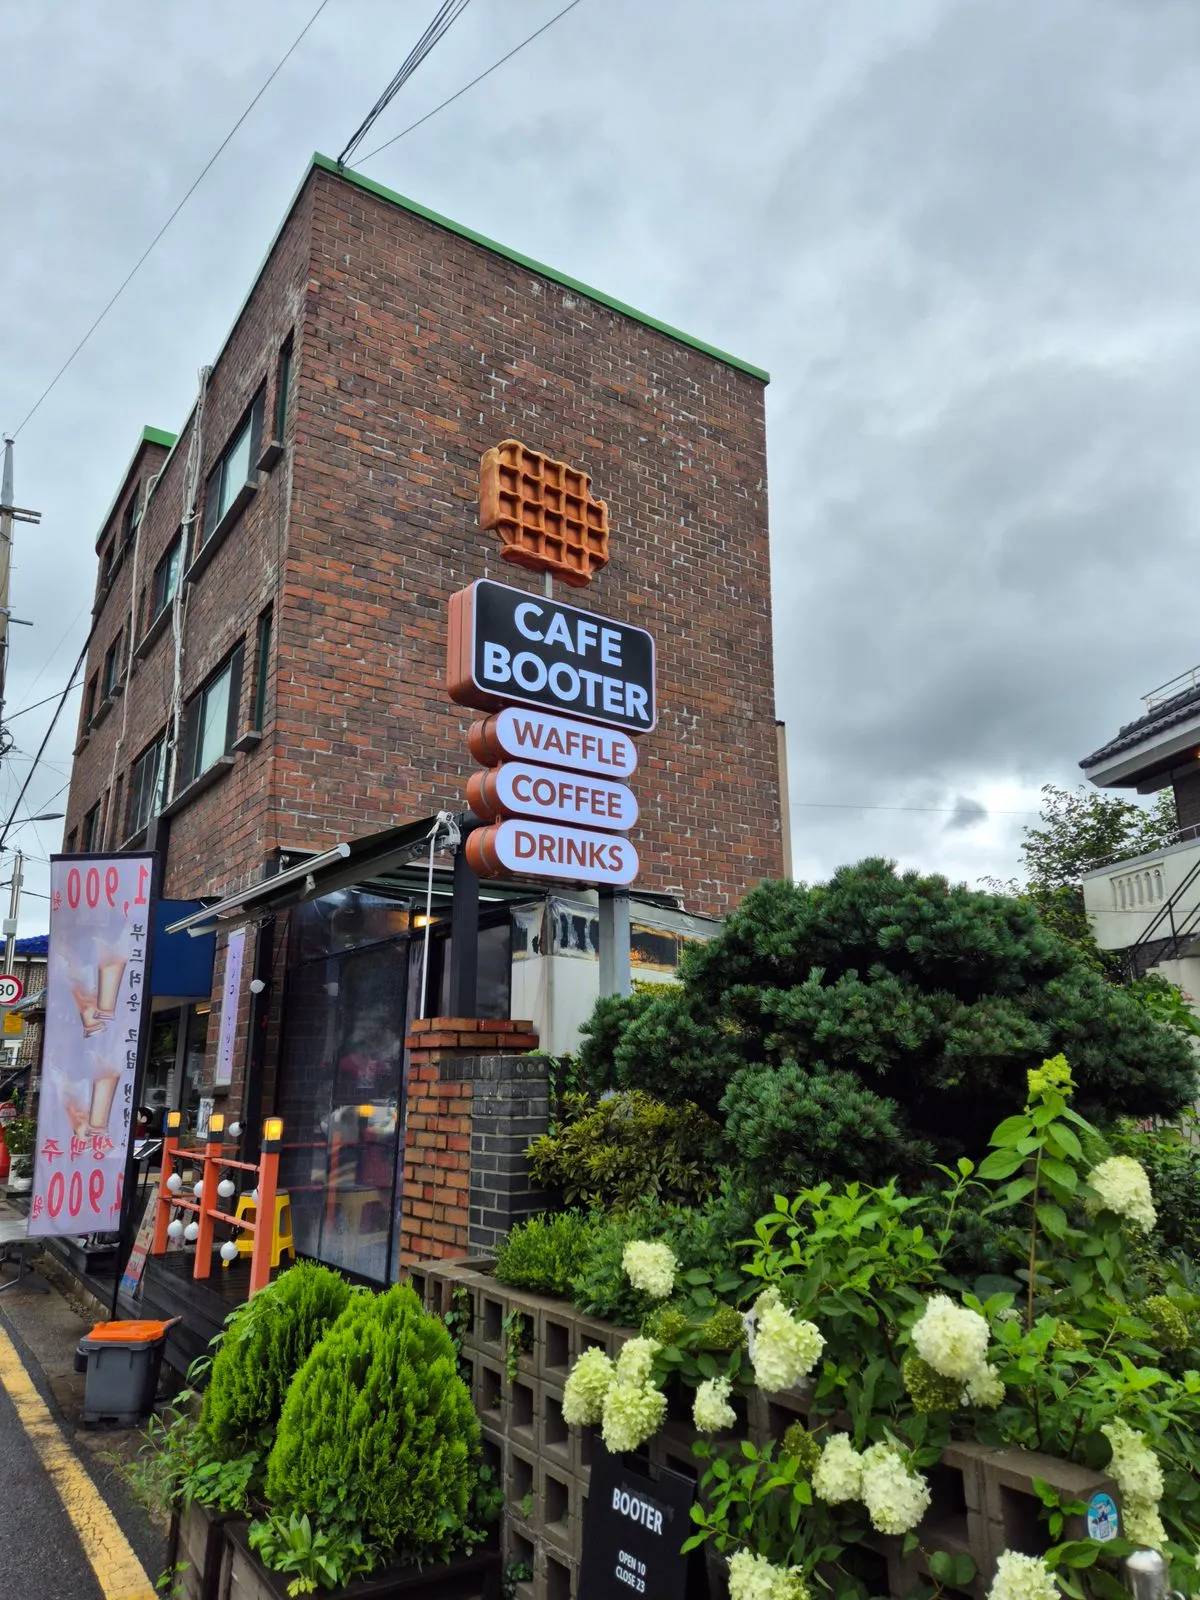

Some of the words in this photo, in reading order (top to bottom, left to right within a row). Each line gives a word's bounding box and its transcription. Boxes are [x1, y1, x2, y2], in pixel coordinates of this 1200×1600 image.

[514, 602, 622, 667] CAFE
[483, 641, 650, 721] BOOTER
[512, 718, 626, 768] WAFFLE
[512, 774, 622, 819] COFFEE
[514, 830, 623, 873] DRINKS
[613, 1488, 662, 1535] BOOTER
[615, 1566, 635, 1587] CLOSE
[636, 1579, 645, 1594] 23
[618, 1550, 636, 1570] OPEN
[637, 1560, 646, 1576] 10
